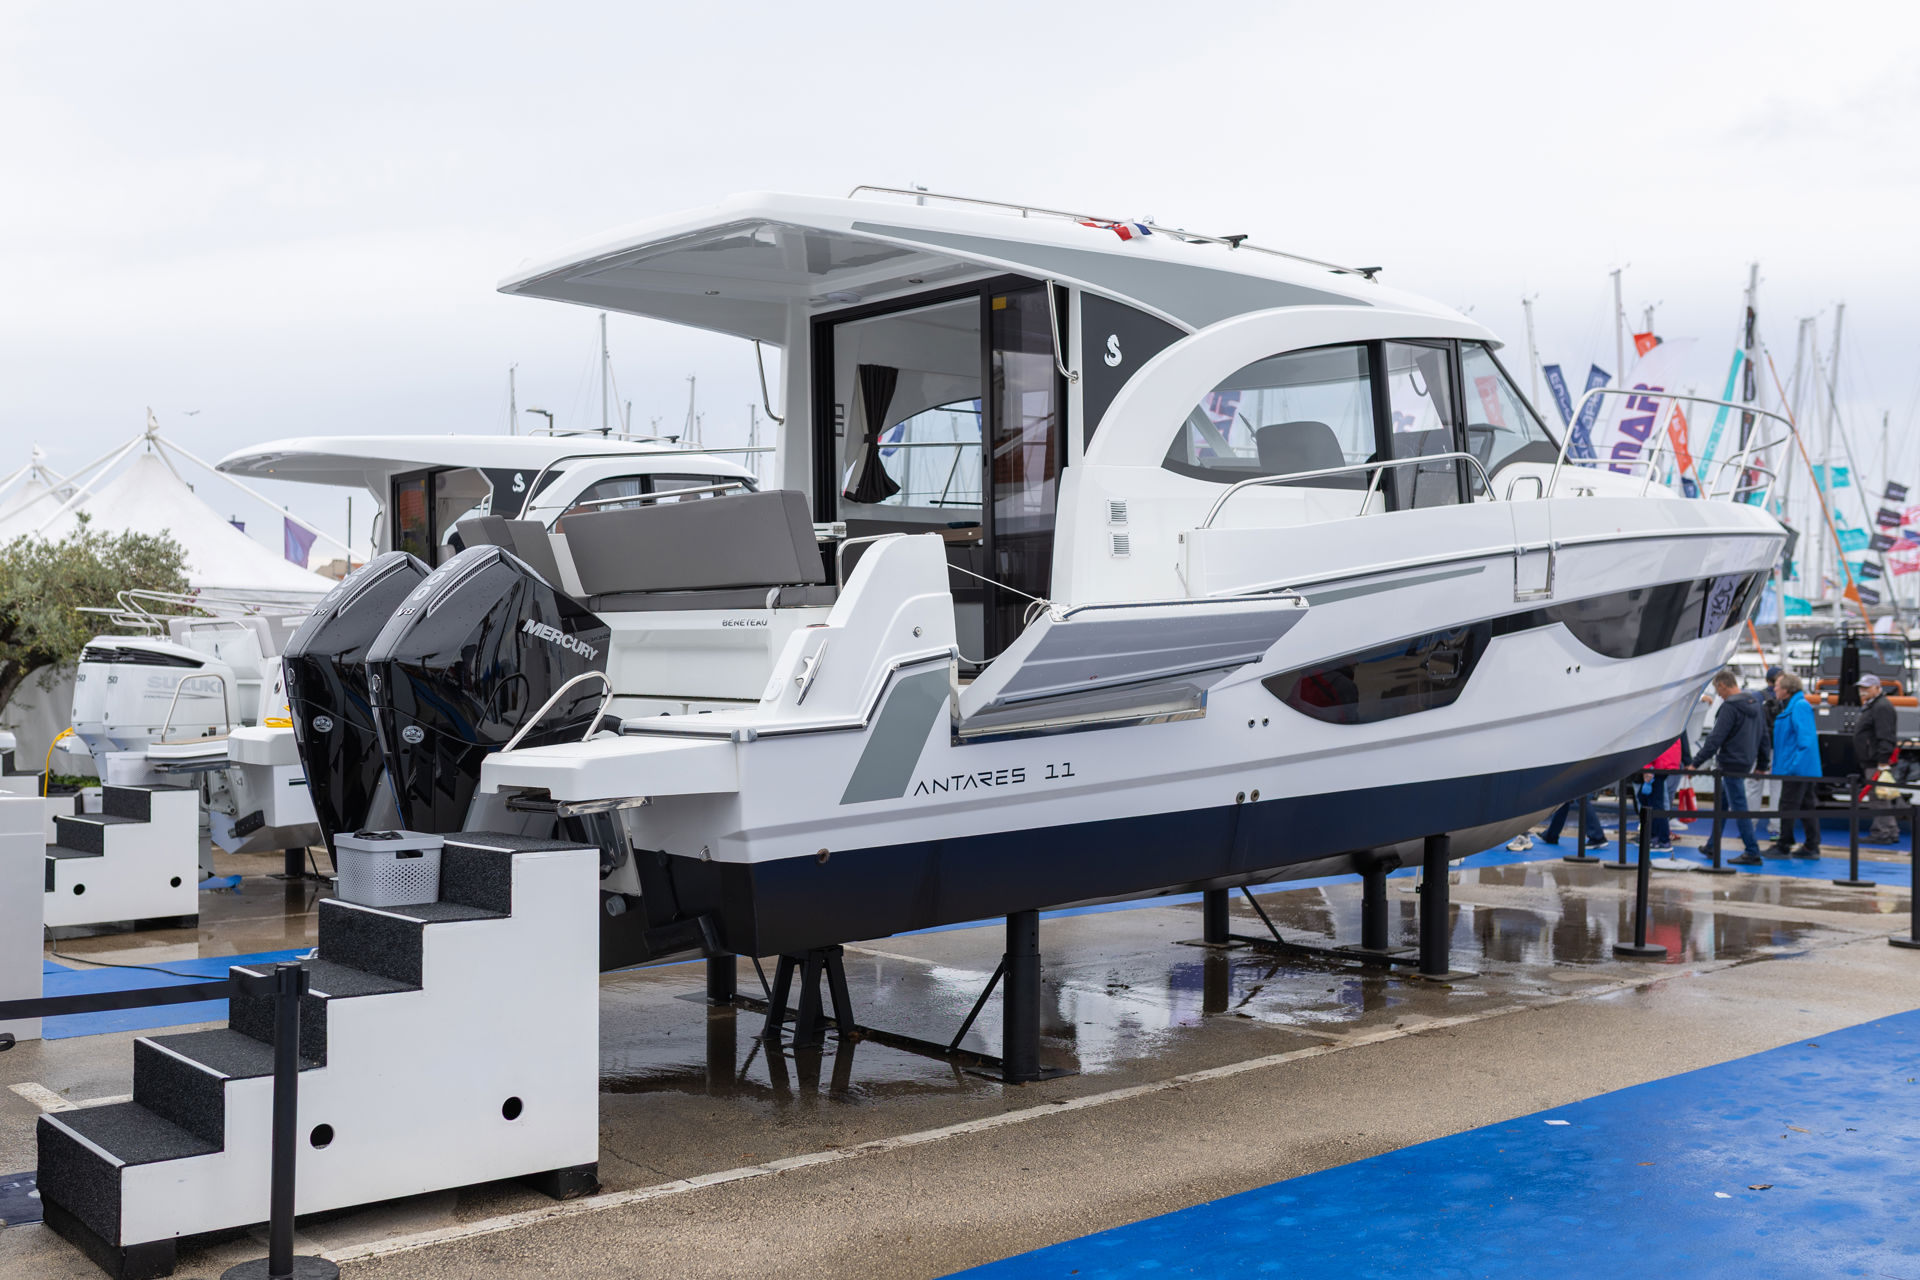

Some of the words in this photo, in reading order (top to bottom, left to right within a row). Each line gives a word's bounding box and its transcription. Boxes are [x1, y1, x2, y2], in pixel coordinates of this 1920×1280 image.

[312, 608, 329, 617] V8
[397, 607, 417, 617] V8
[722, 619, 768, 627] BENETEAU
[521, 618, 599, 661] MERCURY
[147, 675, 222, 694] SUZUKI
[913, 767, 1026, 796] ANTARES
[1045, 762, 1075, 779] 11
